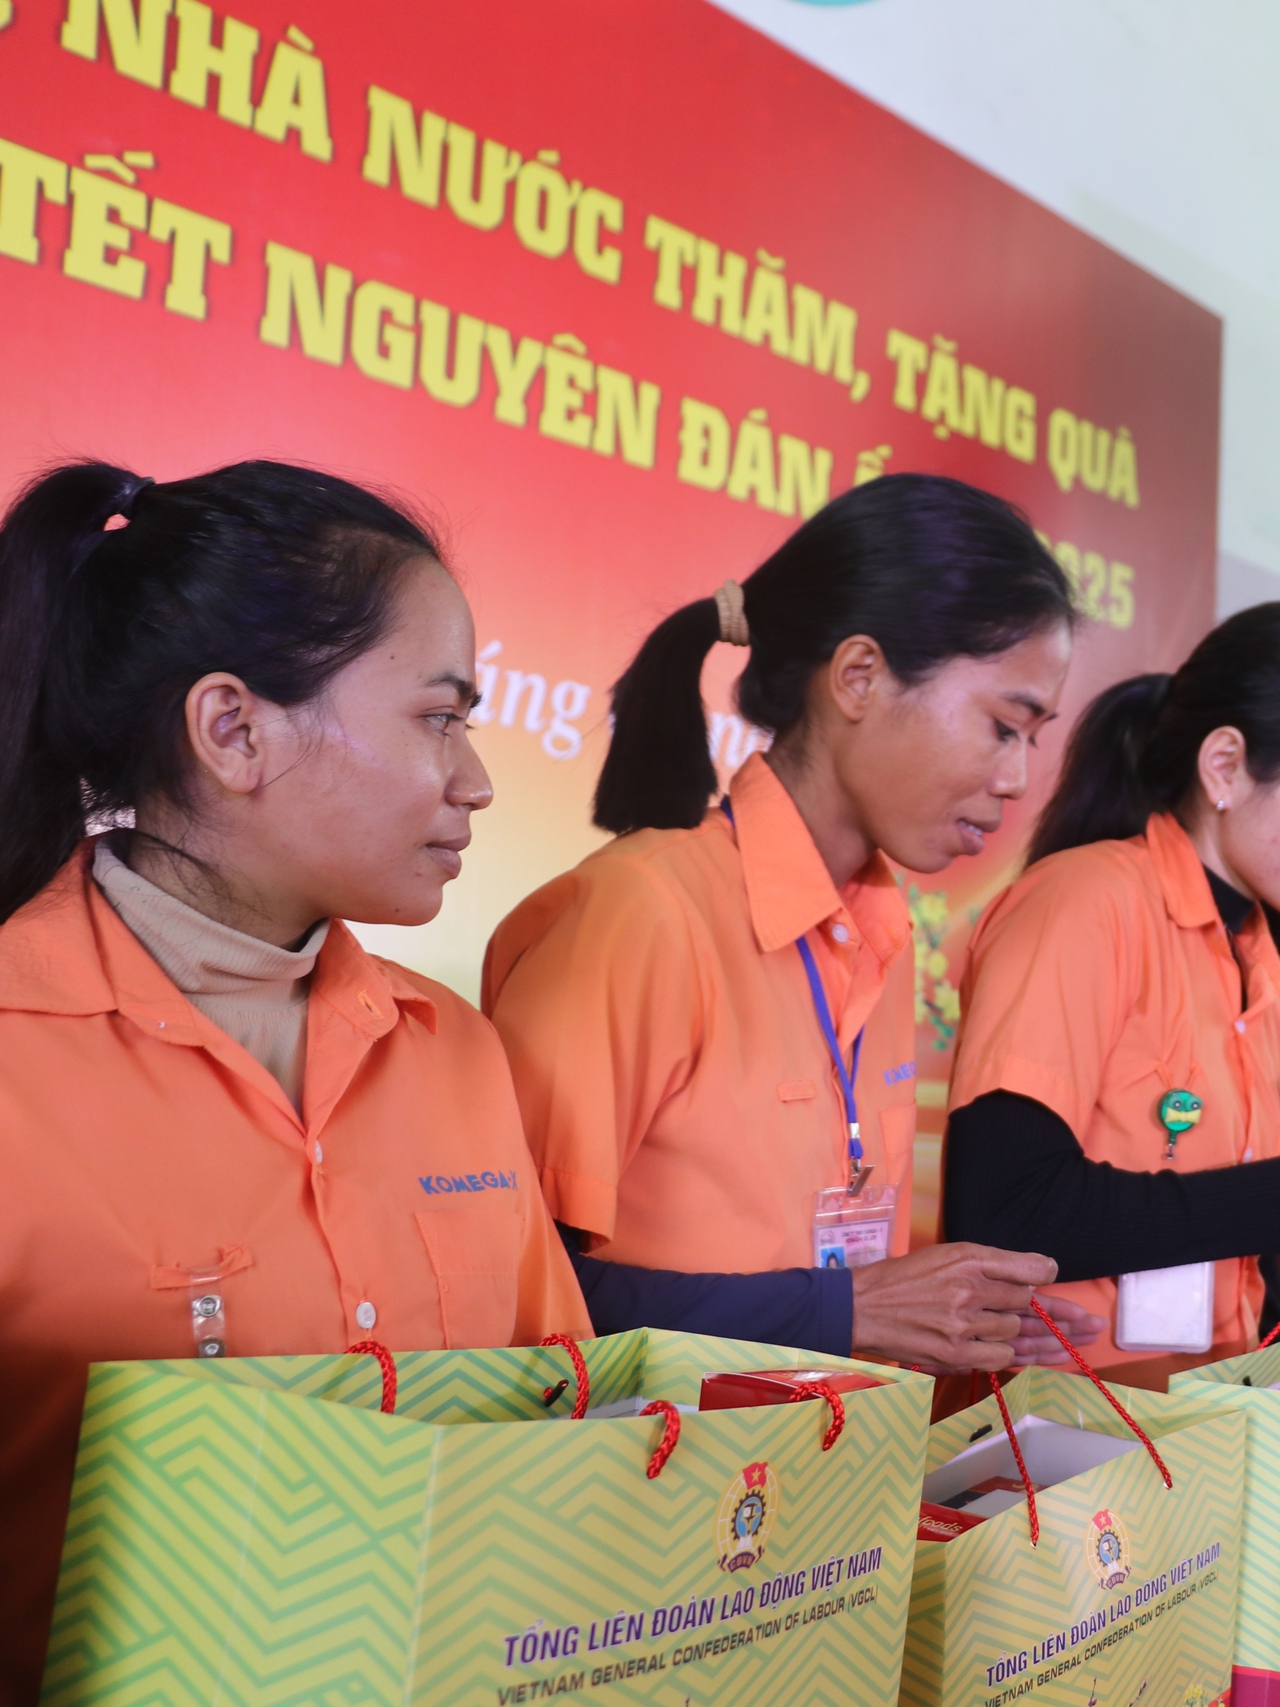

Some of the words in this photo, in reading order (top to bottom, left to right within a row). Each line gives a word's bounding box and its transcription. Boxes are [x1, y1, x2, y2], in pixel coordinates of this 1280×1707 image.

[61, 0, 332, 163] NHÀ
[363, 85, 622, 285] NƯỚC
[645, 215, 870, 402] THĂM,
[886, 329, 1036, 463] TẶNG
[1048, 409, 1140, 509] QUÀ
[0, 137, 232, 321] TẾT
[260, 241, 660, 470] NGUYÊN
[678, 397, 833, 521] ĐÁN
[497, 1671, 585, 1706] VIETNAM
[591, 1653, 667, 1687] GENERAL
[672, 1618, 782, 1667] CONFEDERATION
[785, 1611, 800, 1630] OF
[803, 1594, 846, 1625] LABOUR
[847, 1584, 879, 1613] (VGCL)
[504, 1618, 580, 1667] TỔNG
[587, 1610, 645, 1651] LIÊN
[651, 1595, 716, 1638] ĐOÀN
[720, 1585, 755, 1620] LAO
[759, 1569, 806, 1610] ĐỘNG
[811, 1555, 844, 1592] VIỆT
[847, 1546, 882, 1580] NAM
[986, 1651, 1027, 1687] TỔNG
[1032, 1633, 1066, 1665] LIÊN
[1070, 1611, 1106, 1646] ĐOÀN
[1110, 1594, 1132, 1623] LAO
[1135, 1573, 1167, 1607] ĐỘNG
[1170, 1557, 1193, 1586] VIỆT
[1196, 1542, 1221, 1571] NAM
[1036, 1653, 1082, 1687] GENERAL
[1084, 1610, 1153, 1661] CONFEDERATION
[1155, 1602, 1166, 1618] OF
[1167, 1583, 1196, 1610] LABOUR
